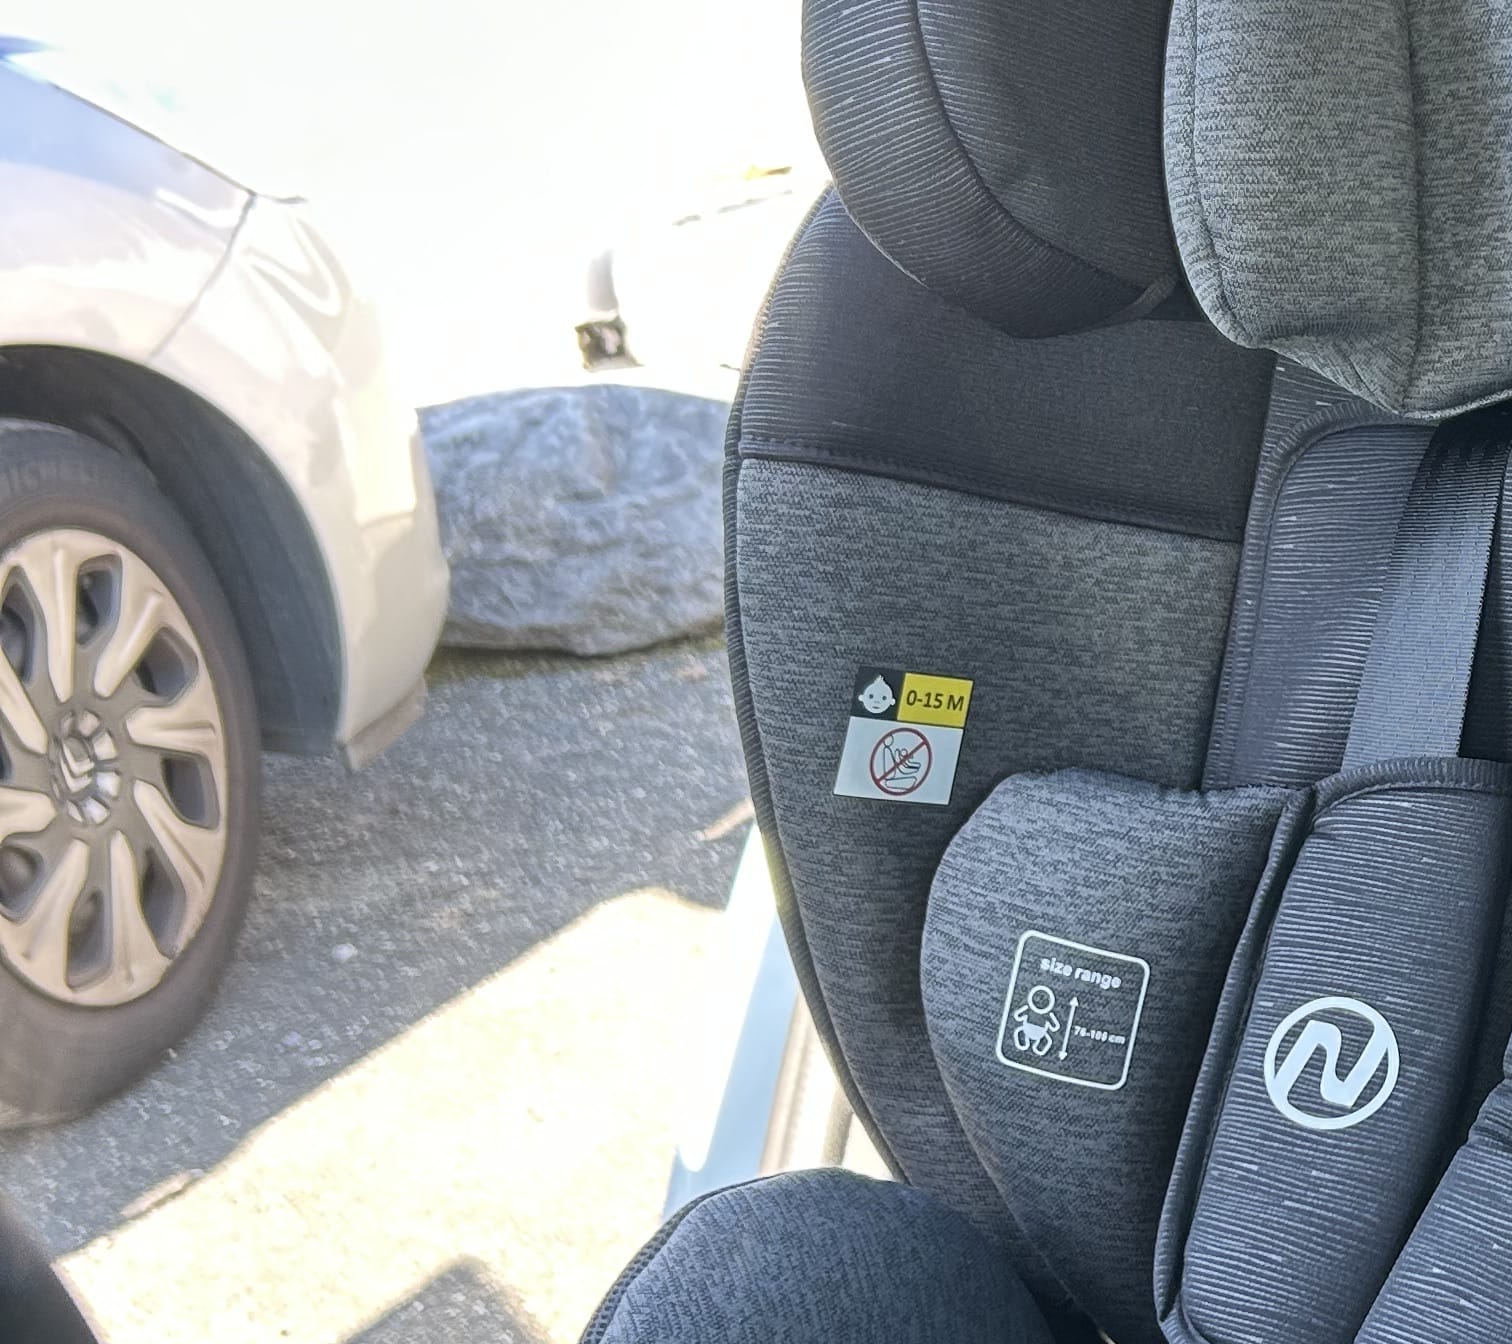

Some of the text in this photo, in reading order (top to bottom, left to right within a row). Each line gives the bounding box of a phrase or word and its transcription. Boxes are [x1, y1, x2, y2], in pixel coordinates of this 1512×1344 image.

[906, 689, 965, 712] 0-15 M
[1040, 957, 1122, 990] size range
